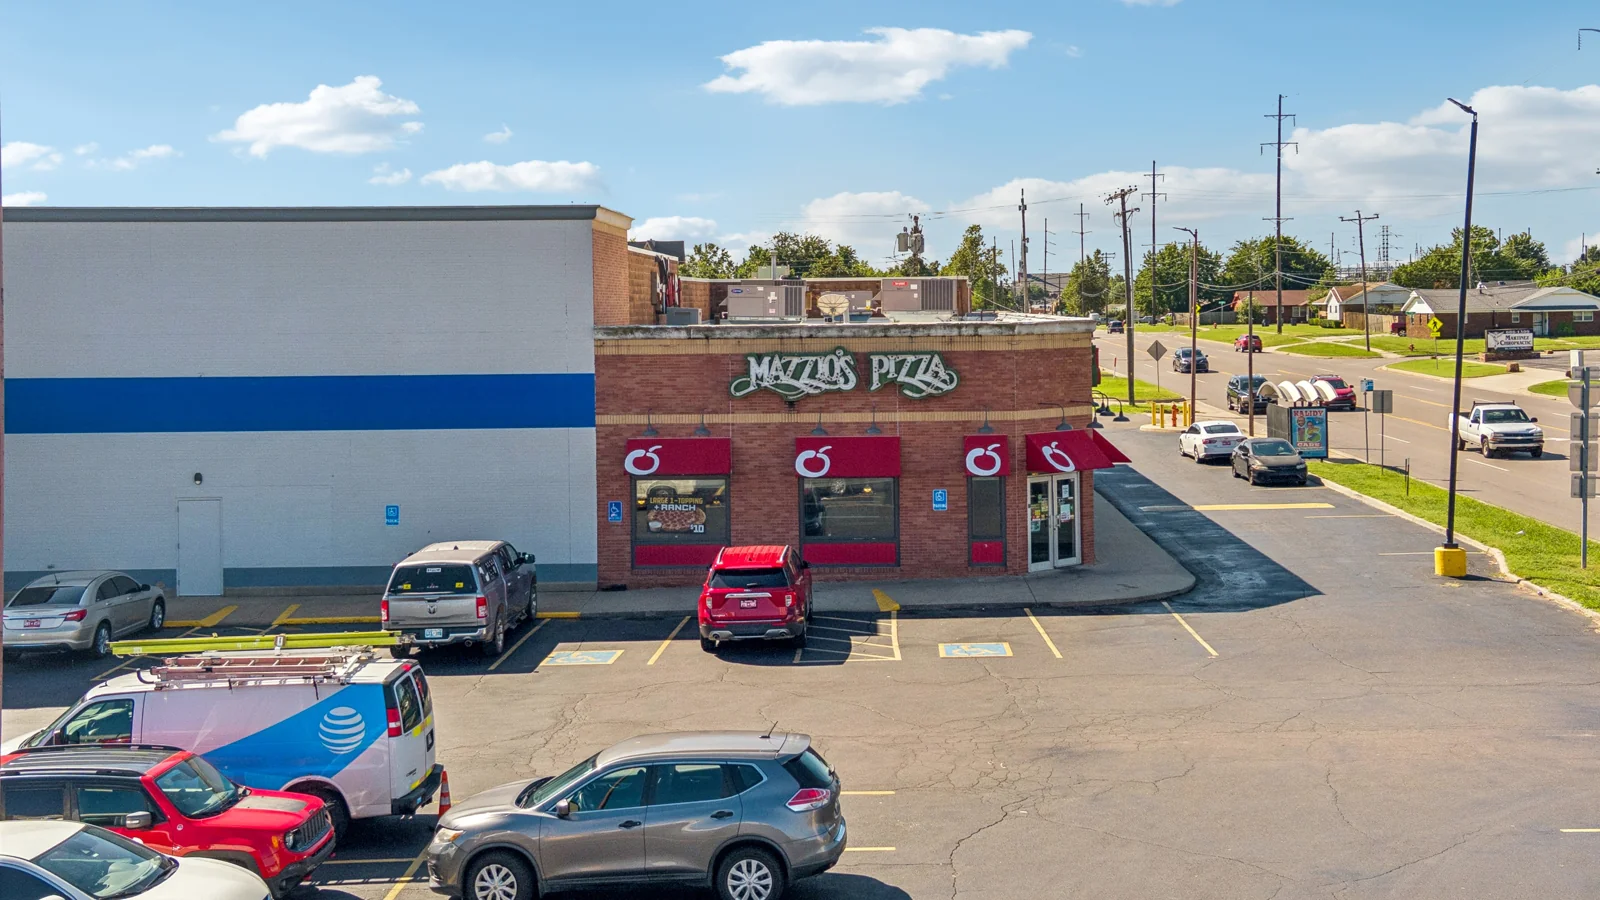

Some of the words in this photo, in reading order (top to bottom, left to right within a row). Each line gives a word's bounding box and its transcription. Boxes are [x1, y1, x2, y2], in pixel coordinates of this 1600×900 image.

[730, 347, 857, 399] MAZZIO'S
[869, 353, 958, 398] PIZZA
[690, 524, 705, 533] $10
